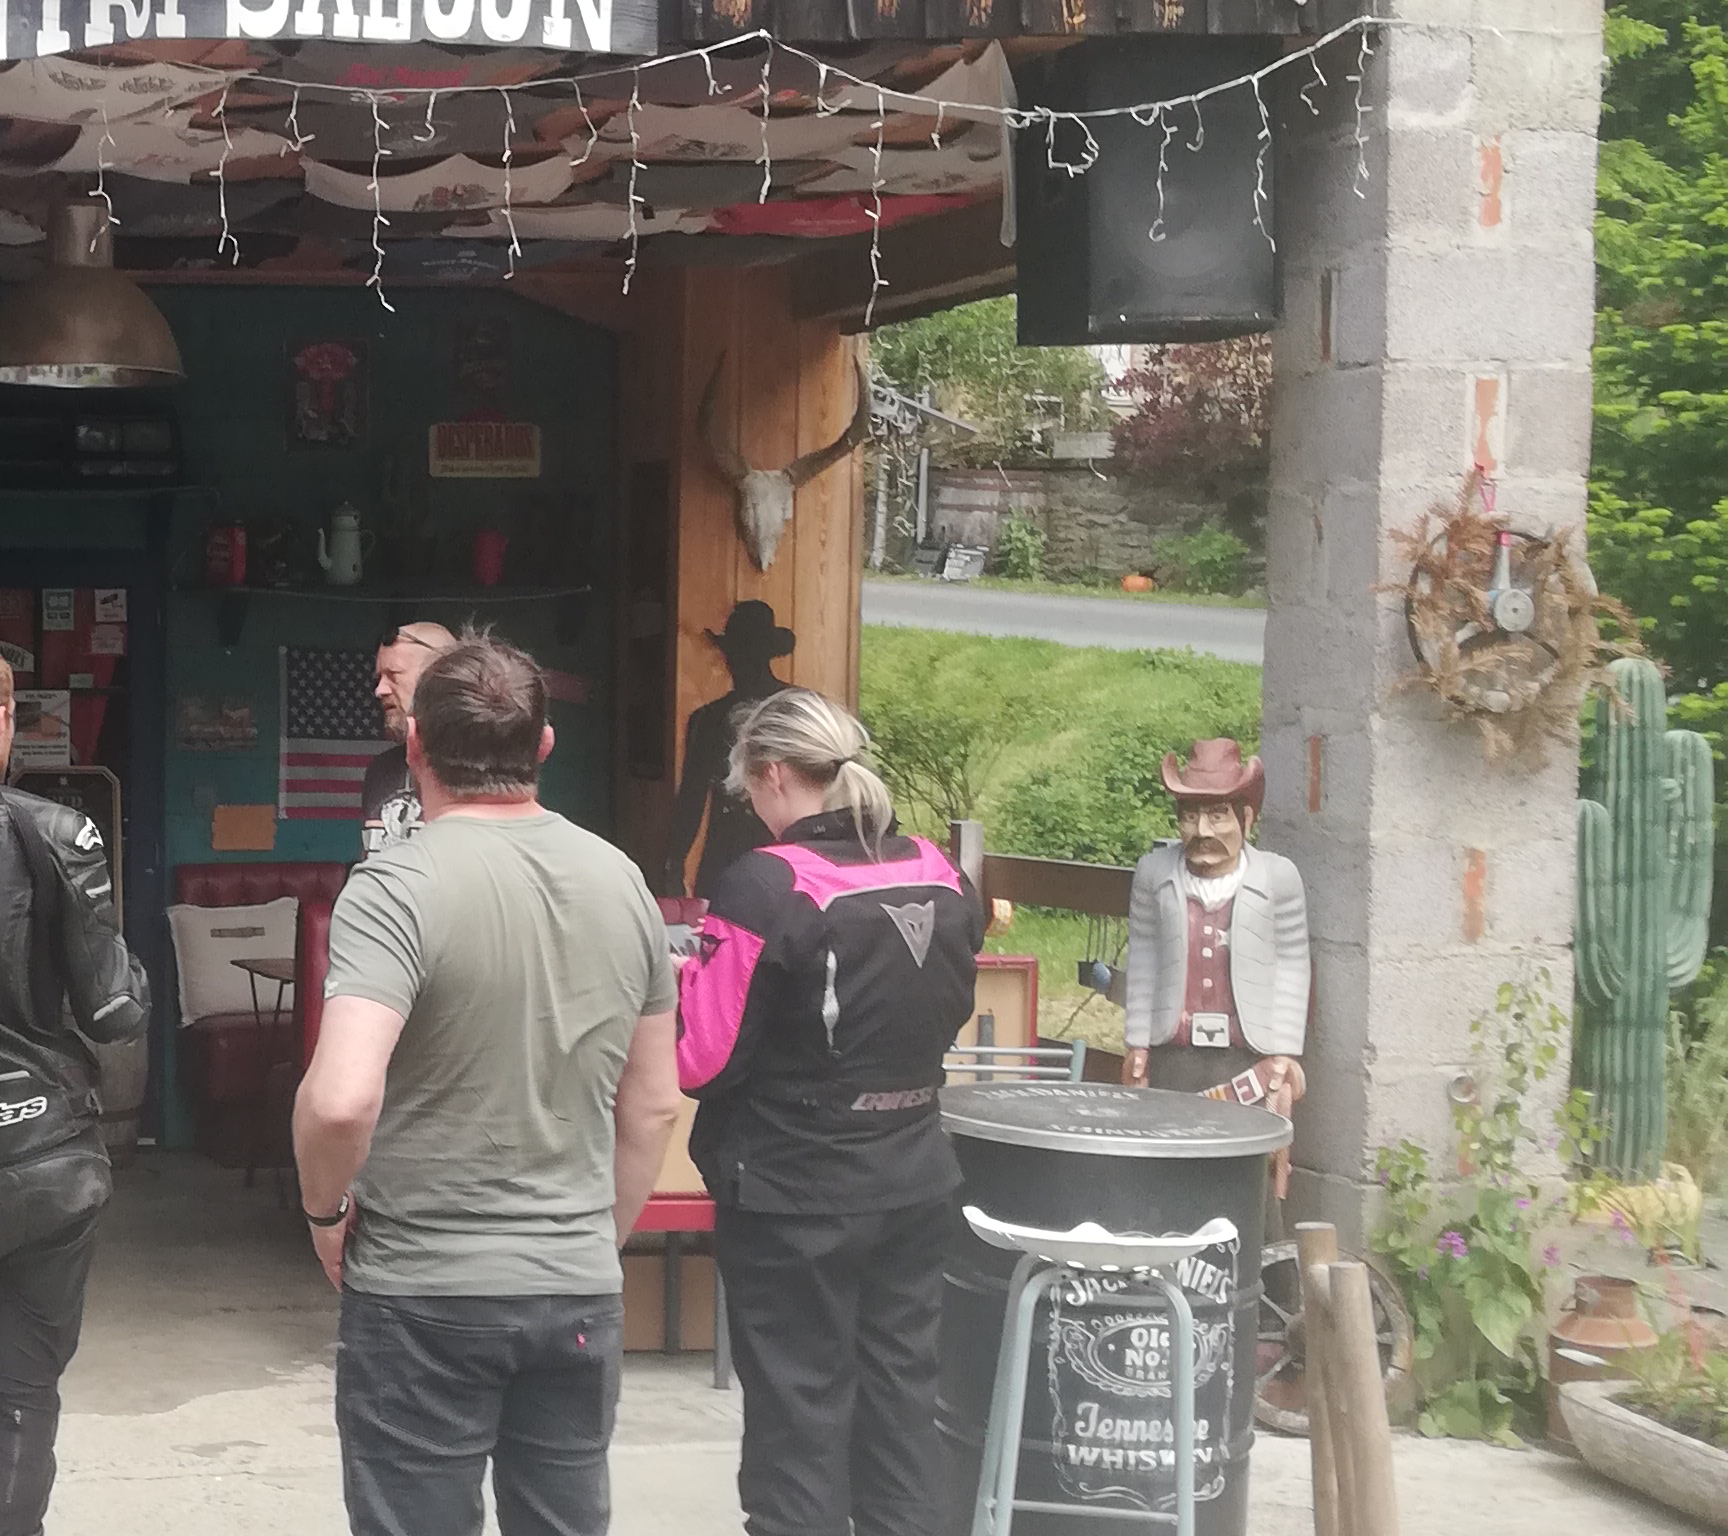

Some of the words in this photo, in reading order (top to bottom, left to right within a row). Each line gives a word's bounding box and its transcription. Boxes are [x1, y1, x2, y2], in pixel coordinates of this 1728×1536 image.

[1176, 1255, 1235, 1305] NIEL'S
[1124, 1367, 1167, 1380] BRAN
[1074, 1401, 1210, 1443] Tennese
[1066, 1443, 1213, 1471] WHISKY
